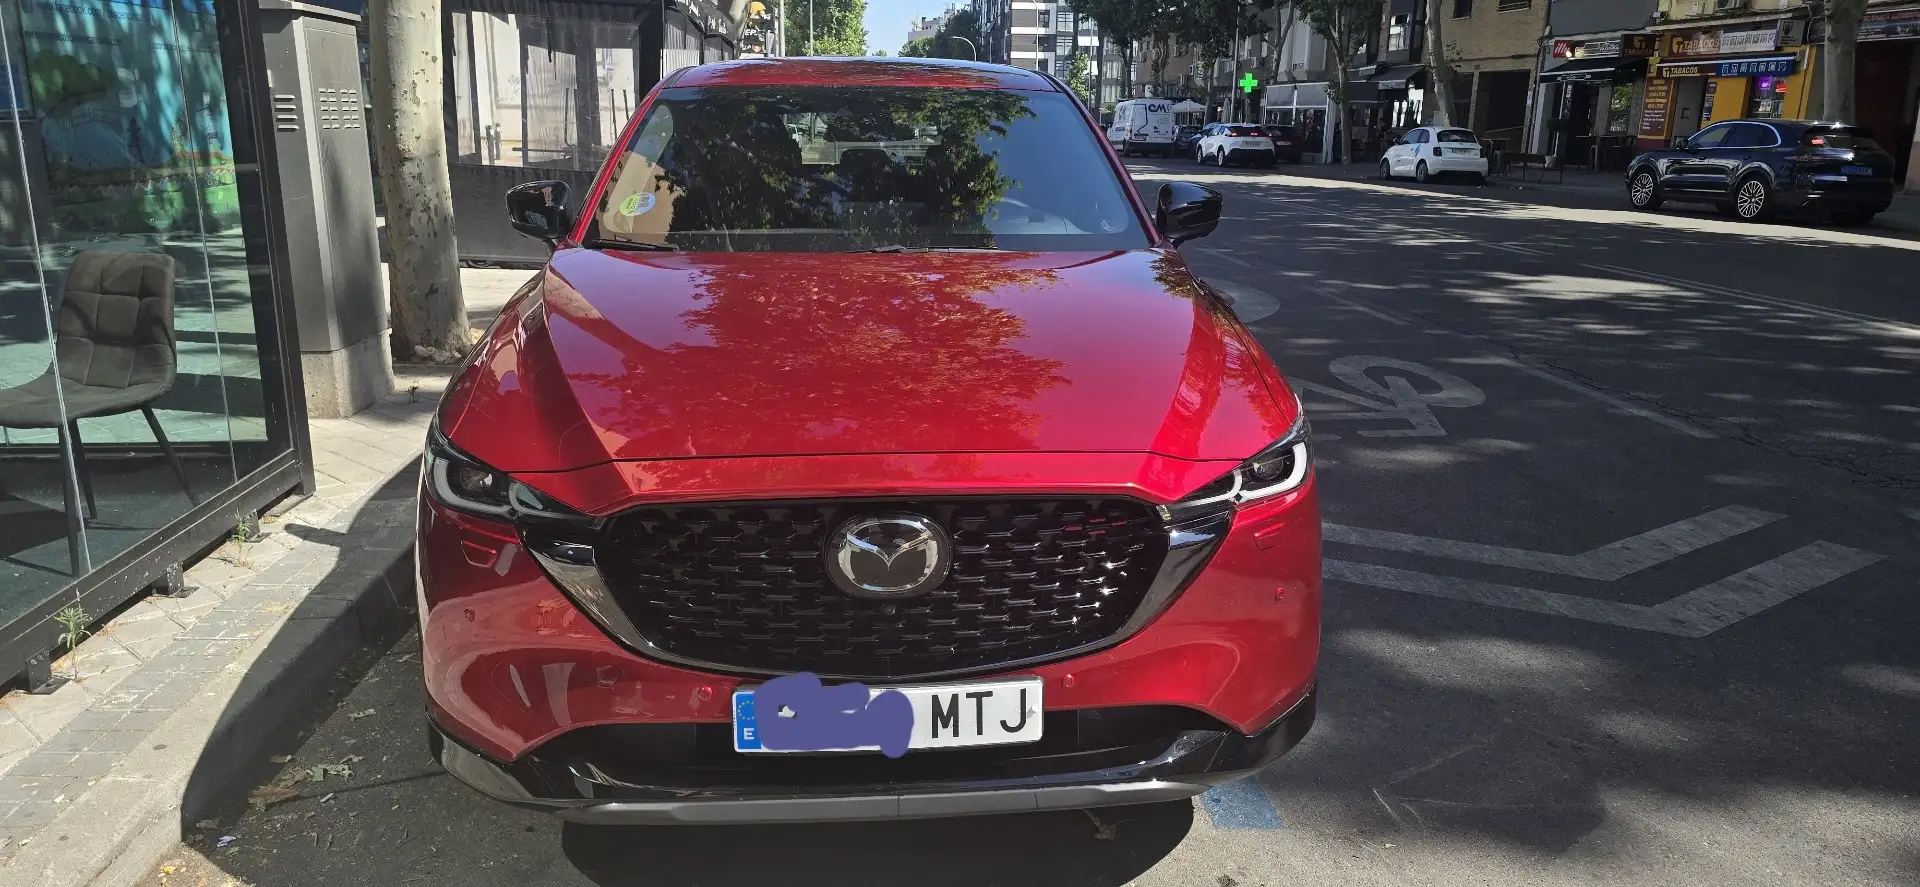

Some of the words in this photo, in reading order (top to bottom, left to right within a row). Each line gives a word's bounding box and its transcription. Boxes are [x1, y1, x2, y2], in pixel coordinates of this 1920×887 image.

[1683, 37, 1720, 50] TABACOS
[1670, 66, 1699, 74] TABACOS
[931, 687, 1028, 739] MTJ
[743, 727, 756, 740] E
